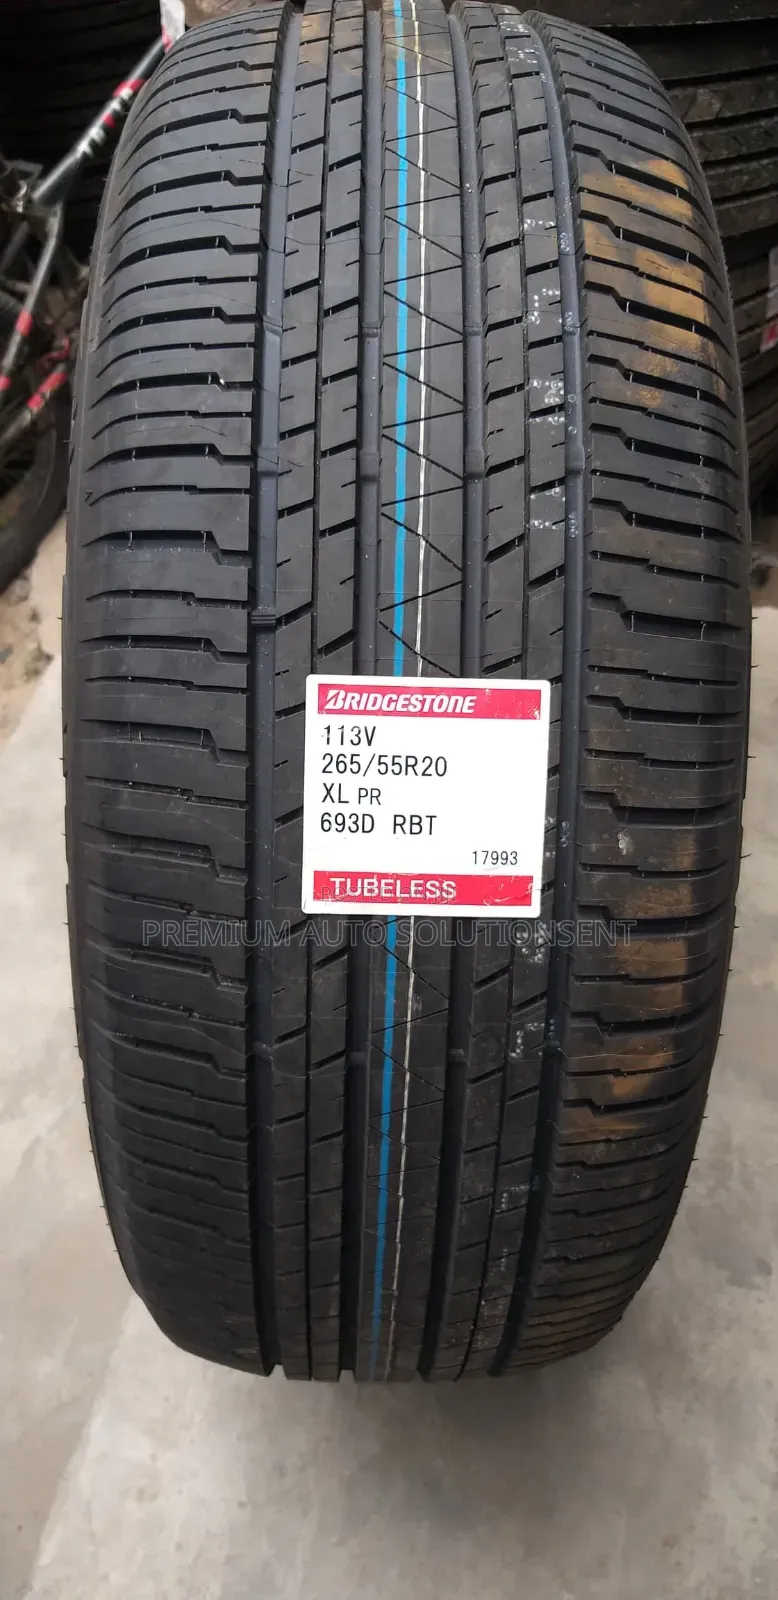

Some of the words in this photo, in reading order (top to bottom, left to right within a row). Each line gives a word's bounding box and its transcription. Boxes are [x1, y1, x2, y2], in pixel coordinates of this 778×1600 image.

[324, 689, 477, 713] BRIDGESTONE
[323, 725, 377, 746] 113V
[321, 753, 448, 777] 265/55R20
[321, 783, 349, 804] XL
[357, 788, 382, 805] PR
[320, 812, 375, 834] 693D
[392, 814, 437, 835] RBT
[472, 850, 518, 865] 17993
[330, 877, 457, 899] TUBELESS
